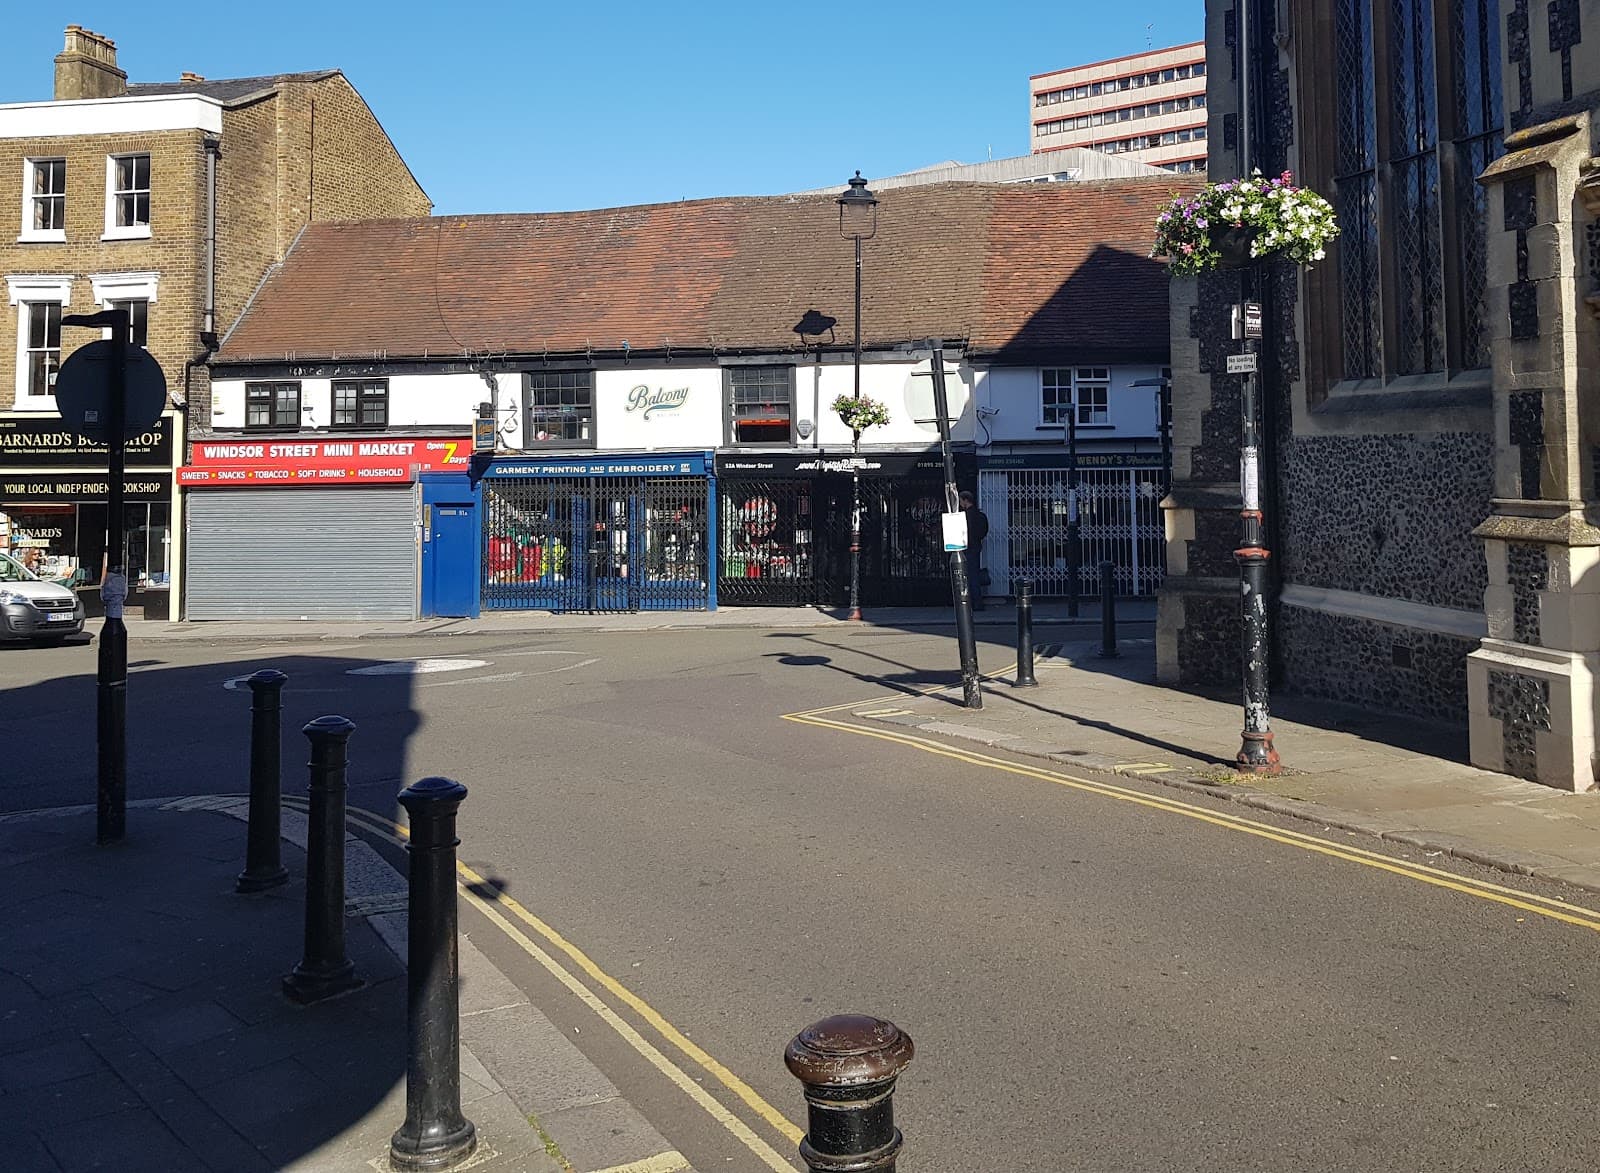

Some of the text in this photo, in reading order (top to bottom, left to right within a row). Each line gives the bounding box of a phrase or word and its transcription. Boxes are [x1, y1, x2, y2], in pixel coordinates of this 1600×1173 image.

[1237, 355, 1253, 363] loading
[626, 385, 688, 420] Balcony
[204, 443, 415, 458] WINDSOR STREET MINI MARKET
[427, 442, 445, 450] Open
[442, 442, 457, 464] 7
[1077, 455, 1122, 465] WENDY'S
[181, 468, 404, 480] SWEETS SNACKS TOBACCO SOFT DRINKS HOUSEHOLD
[542, 466, 586, 474] PRINTING
[608, 464, 676, 473] EMBROIDERY
[5, 482, 161, 494] YOUR LOCAL INDEPENDEN OOKSHOP
